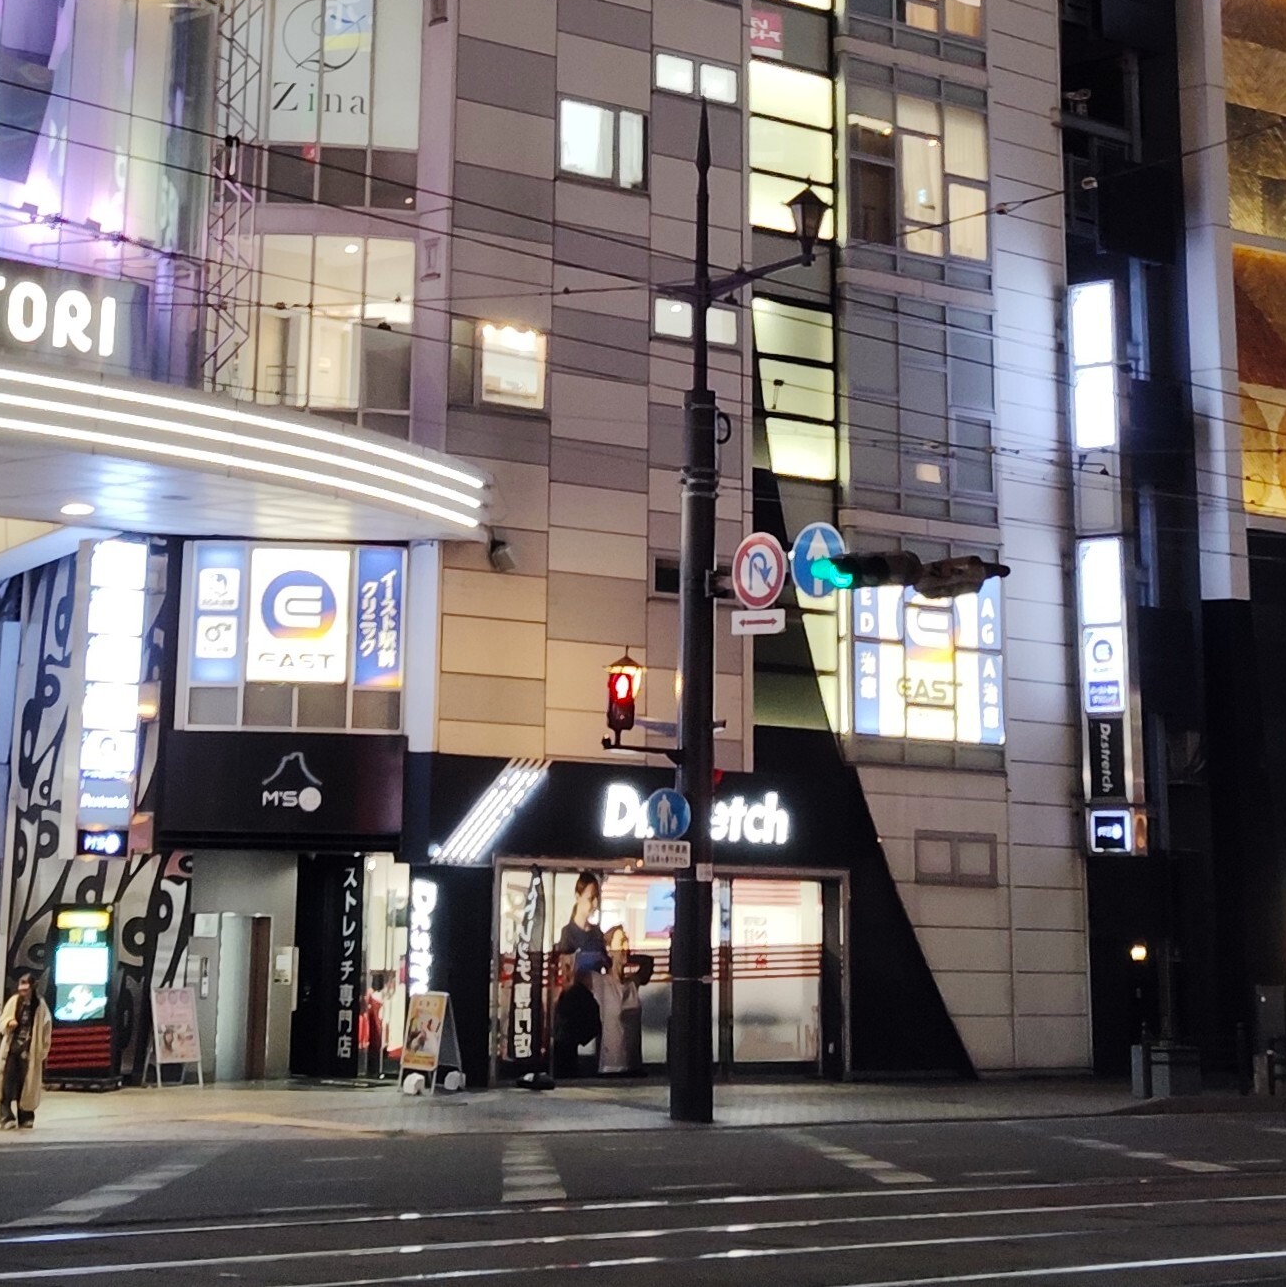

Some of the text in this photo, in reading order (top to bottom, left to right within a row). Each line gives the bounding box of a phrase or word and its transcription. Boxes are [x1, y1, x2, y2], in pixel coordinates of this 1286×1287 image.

[272, 81, 368, 115] Zina
[359, 581, 379, 658] クリニック
[337, 867, 358, 1059] ストレッチ専門店
